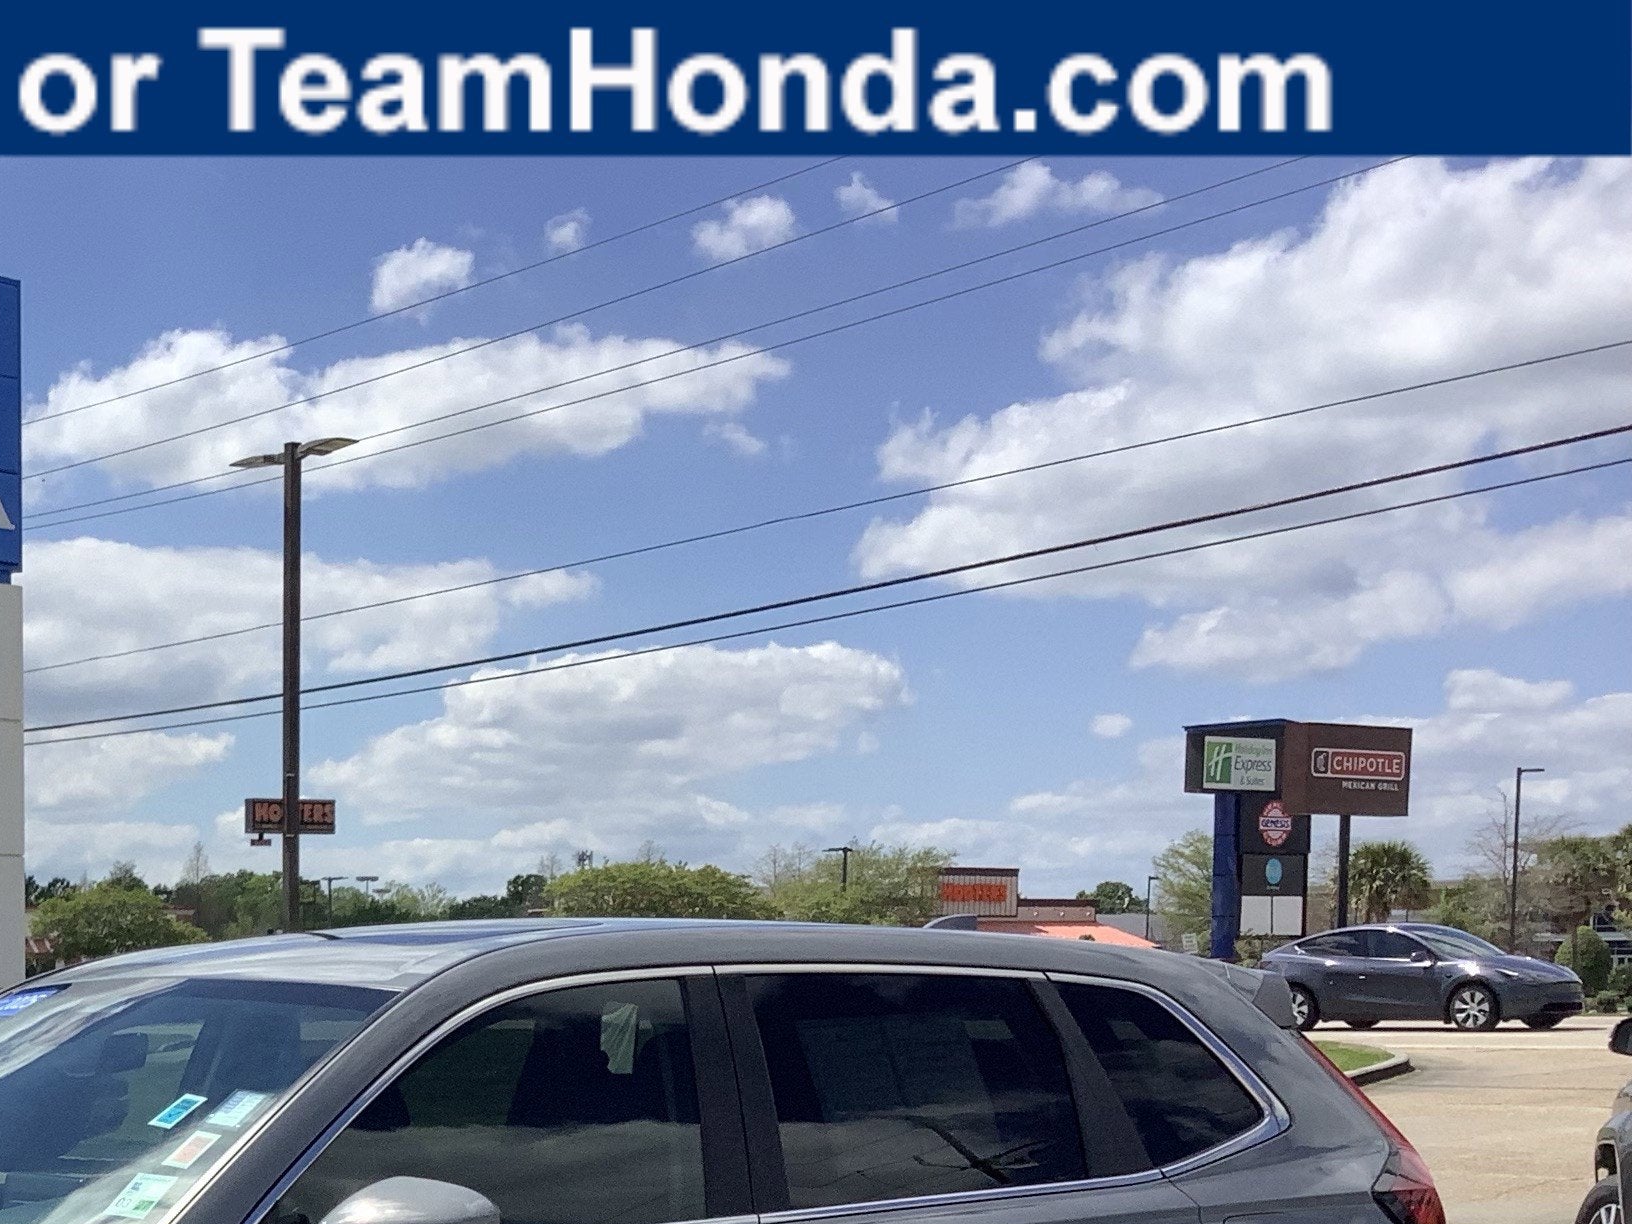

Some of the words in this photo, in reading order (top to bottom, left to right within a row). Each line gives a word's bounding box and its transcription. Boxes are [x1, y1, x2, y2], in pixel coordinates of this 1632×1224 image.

[1234, 755, 1272, 774] Express
[1333, 756, 1401, 774] CHIPOTLE
[1342, 780, 1376, 790] MEXICAN
[1377, 782, 1399, 791] GRILL
